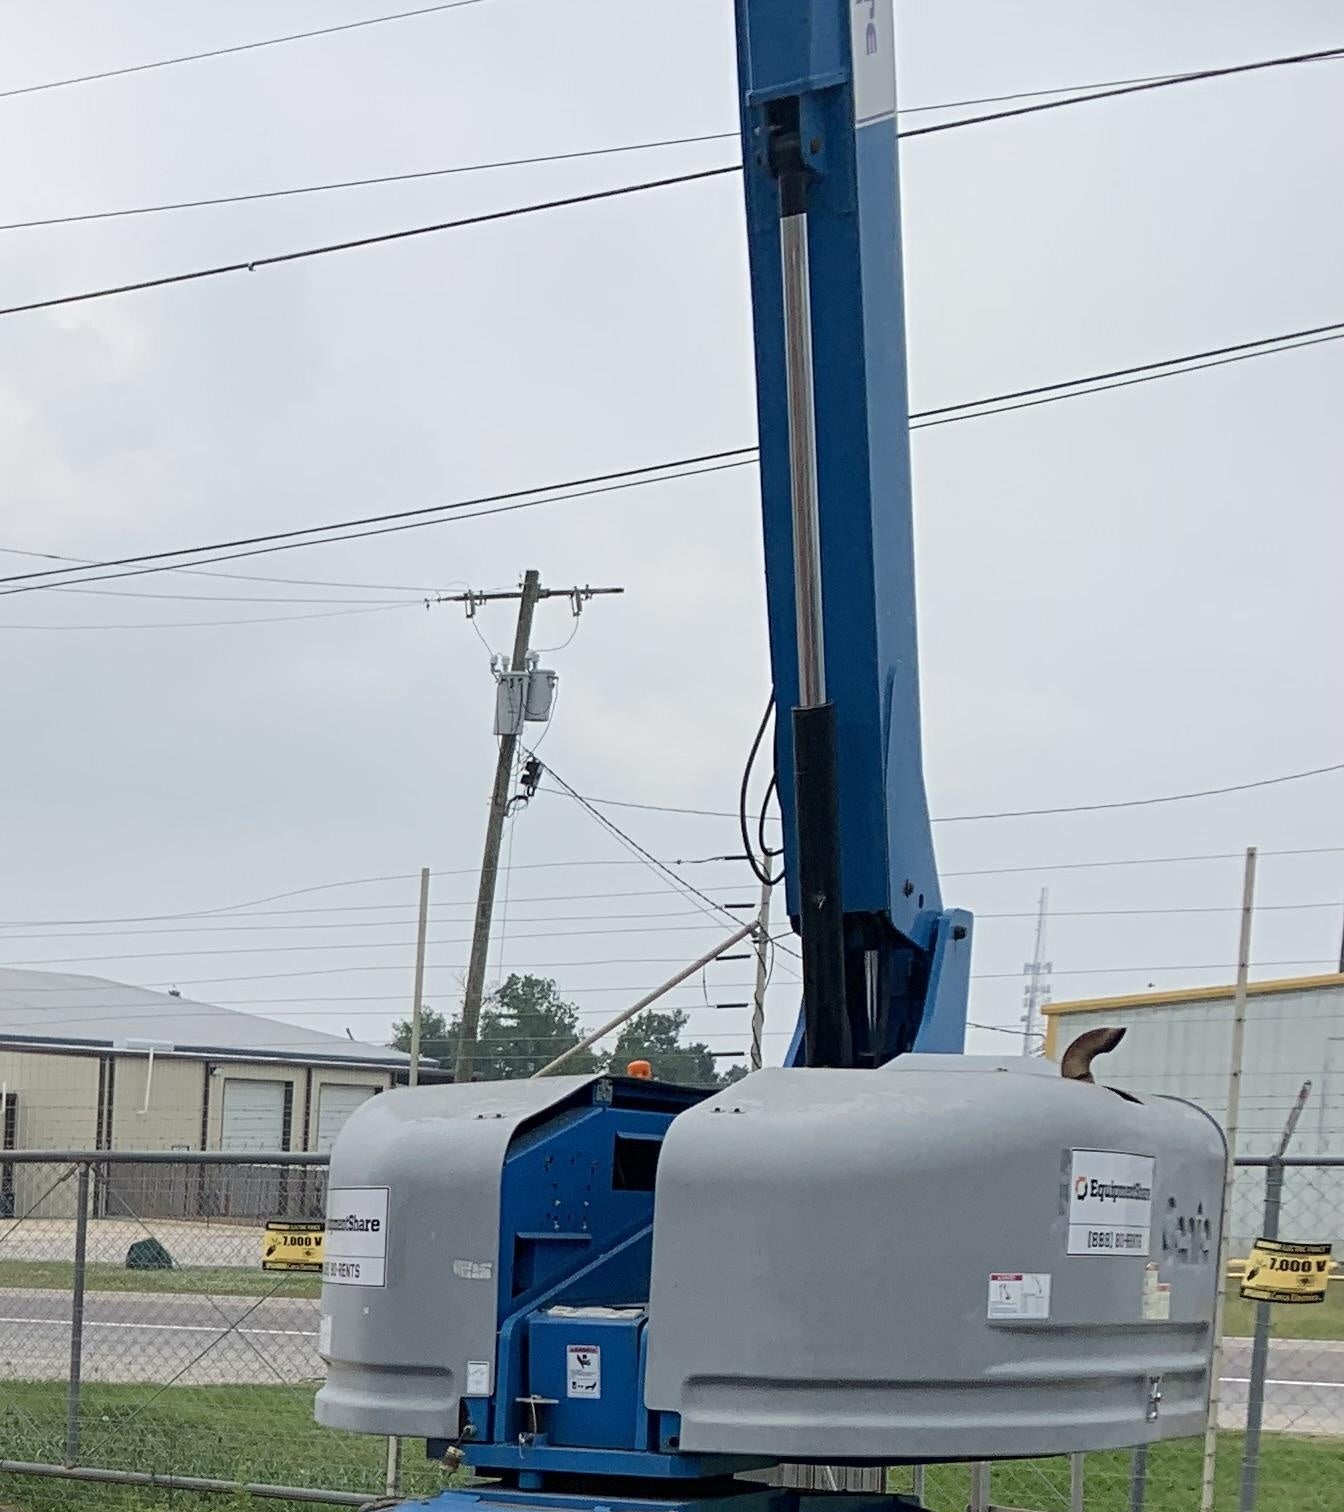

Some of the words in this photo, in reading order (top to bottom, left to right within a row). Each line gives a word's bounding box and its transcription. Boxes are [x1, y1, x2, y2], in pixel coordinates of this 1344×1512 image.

[315, 1236, 322, 1246] V
[1269, 1257, 1311, 1272] 7,000
[1316, 1259, 1326, 1272] V
